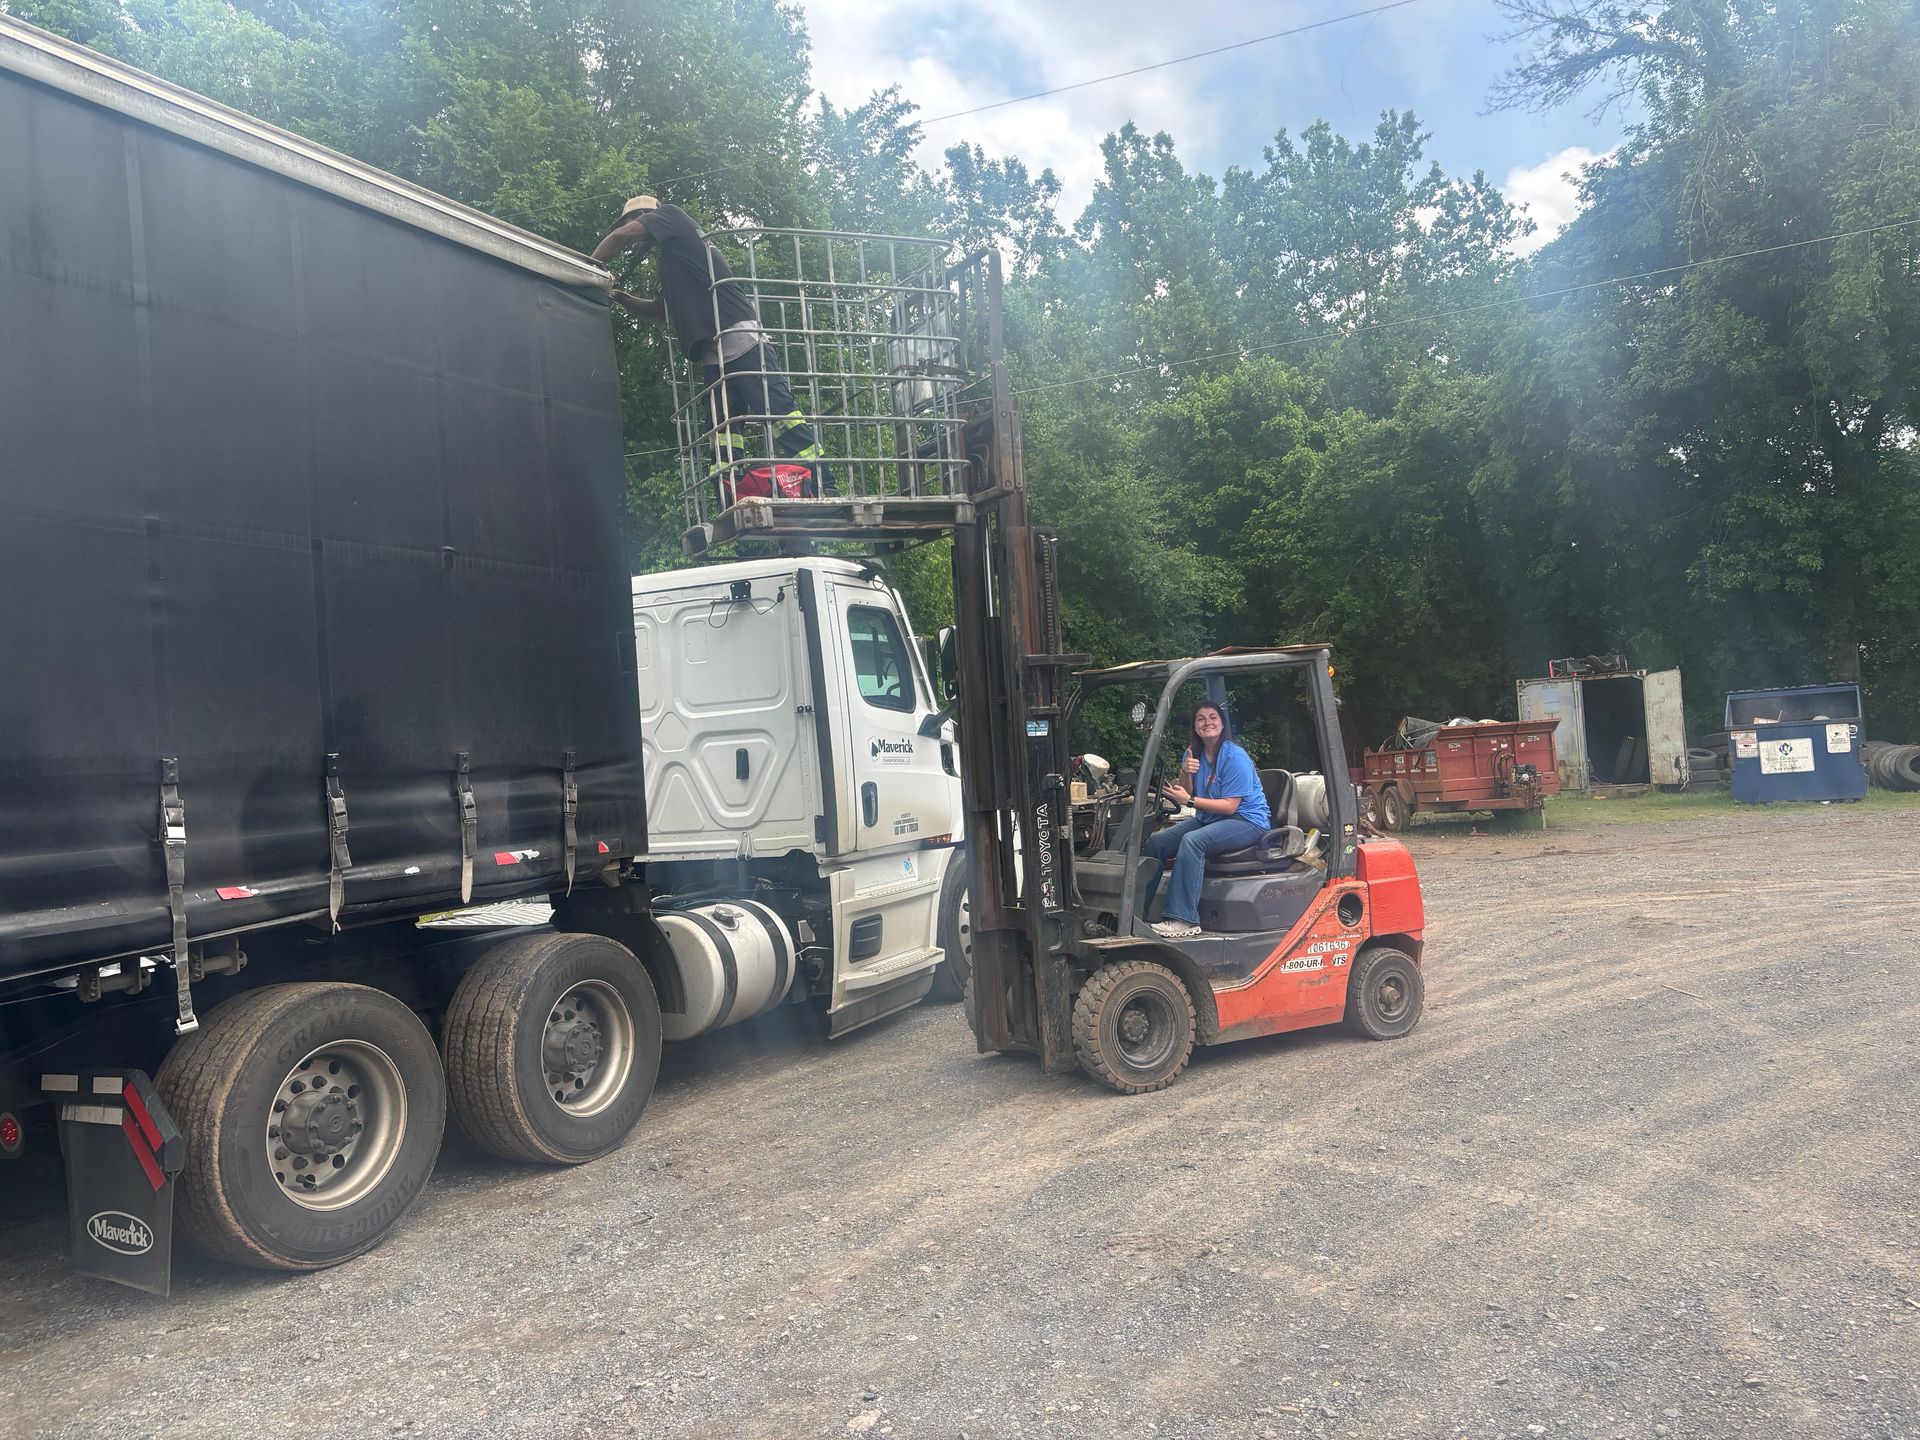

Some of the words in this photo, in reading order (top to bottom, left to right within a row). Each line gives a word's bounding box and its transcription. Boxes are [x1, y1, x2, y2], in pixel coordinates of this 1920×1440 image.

[877, 737, 913, 753] Maverick
[1036, 803, 1052, 876] TOYOTA
[93, 1218, 148, 1247] Maverick
